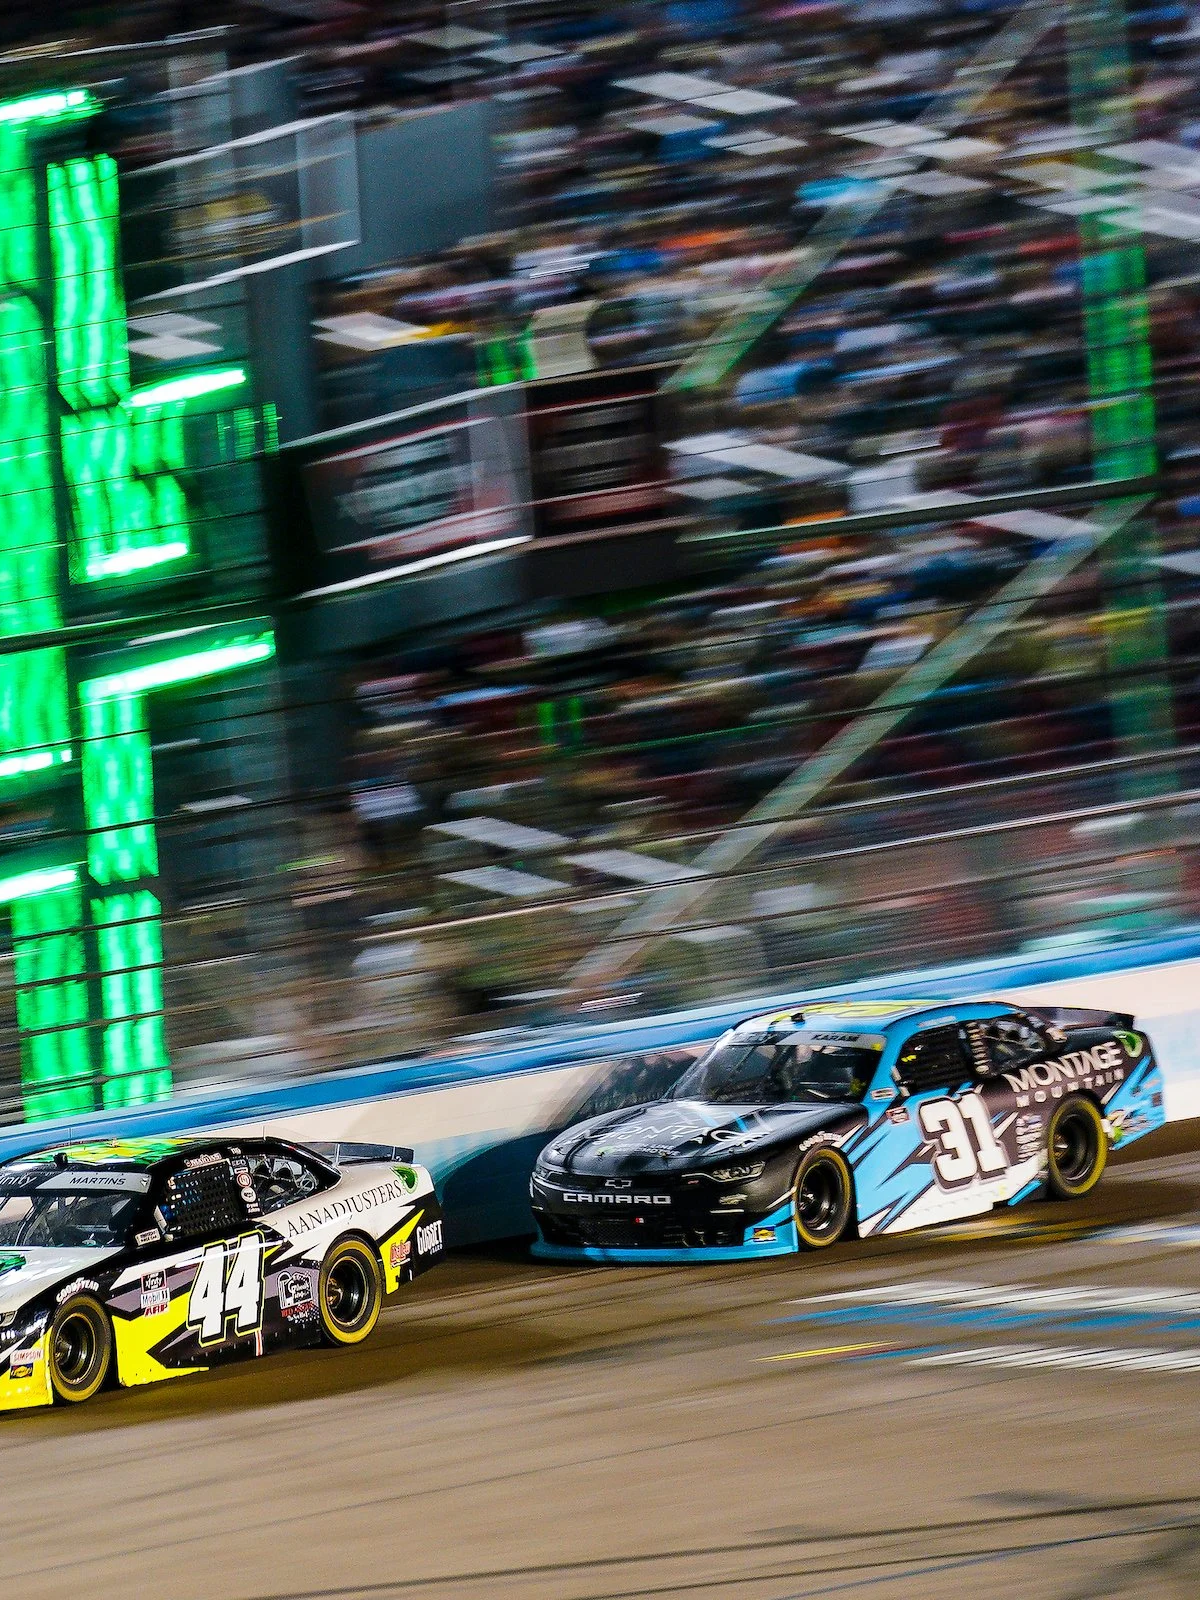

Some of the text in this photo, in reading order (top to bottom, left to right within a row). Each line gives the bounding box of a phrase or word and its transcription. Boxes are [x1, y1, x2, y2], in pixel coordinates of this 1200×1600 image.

[810, 1034, 860, 1043] KARAM
[1000, 1041, 1124, 1093] MONTAGE
[918, 1091, 1008, 1186] 31
[69, 1177, 126, 1186] MARTINS
[562, 1192, 672, 1204] CAMARO
[55, 1276, 100, 1304] GOODYEAR
[187, 1231, 263, 1343] 44
[12, 1350, 42, 1362] SIMPSON
